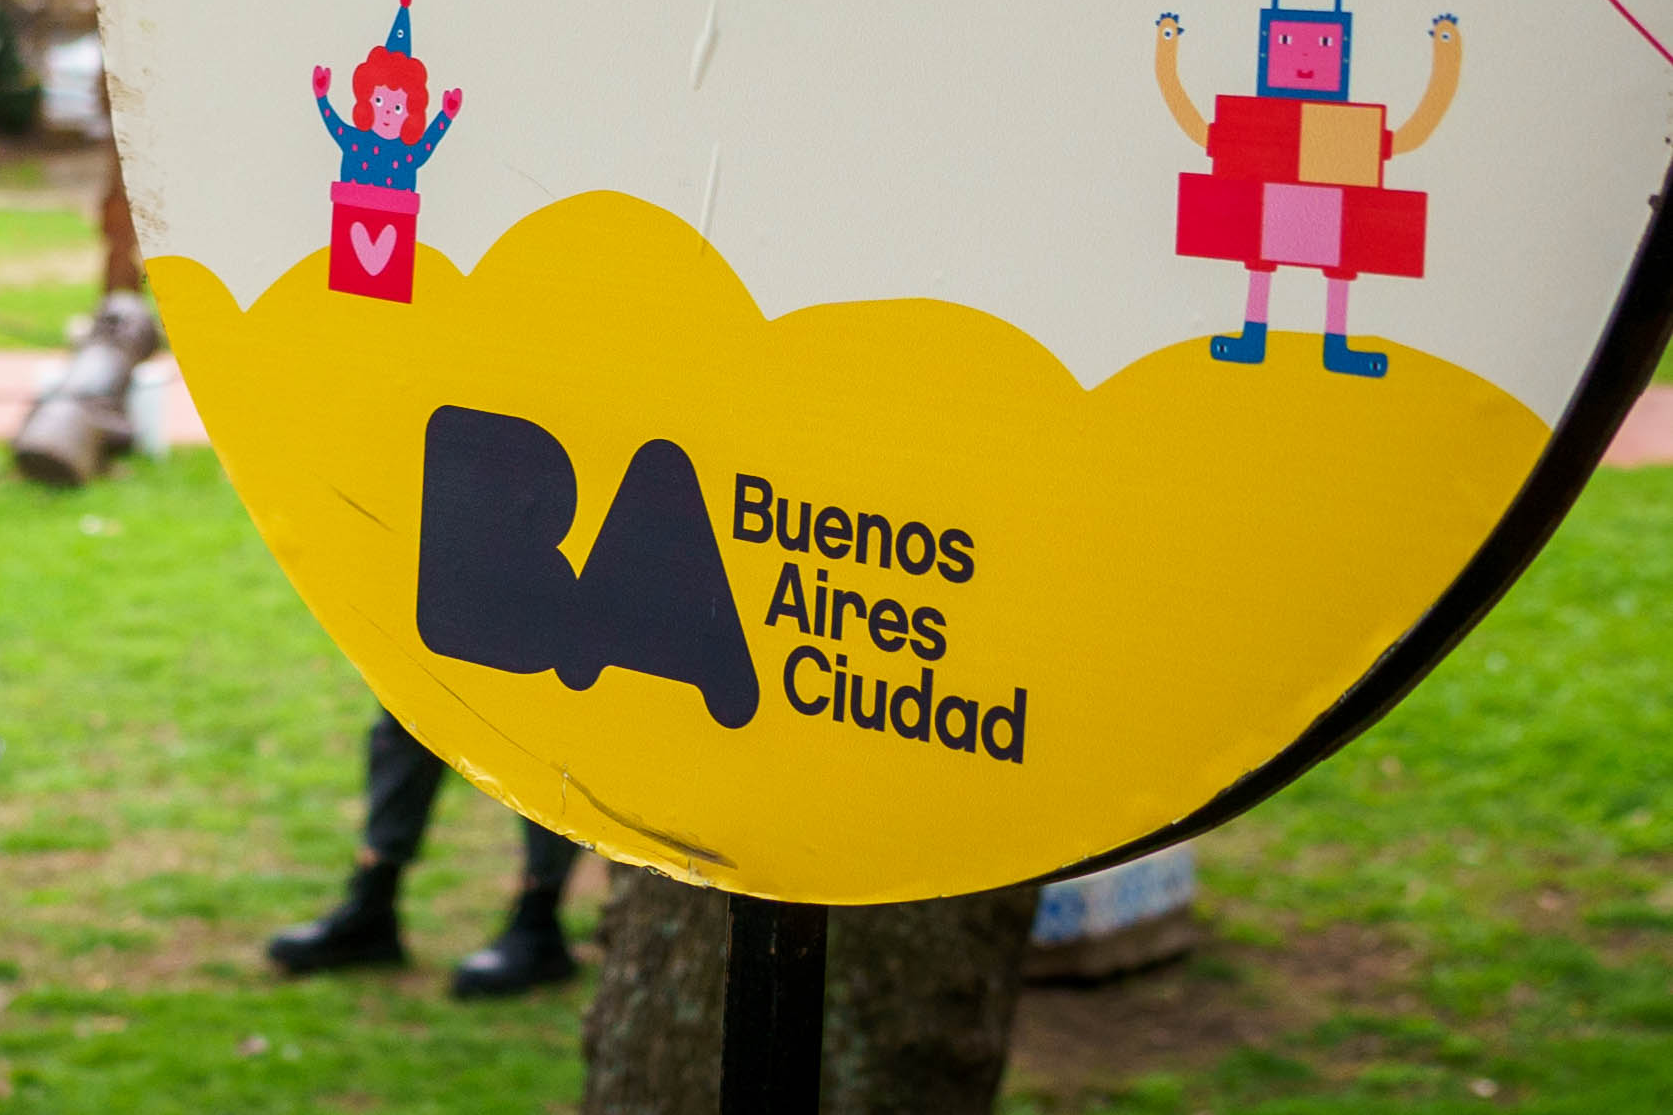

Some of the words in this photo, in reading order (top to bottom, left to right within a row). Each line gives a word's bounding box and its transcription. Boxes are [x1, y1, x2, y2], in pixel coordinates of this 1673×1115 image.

[416, 404, 760, 729] BA
[732, 472, 975, 583] Buenos
[764, 561, 947, 662] Aires
[783, 644, 1028, 764] Ciudad
